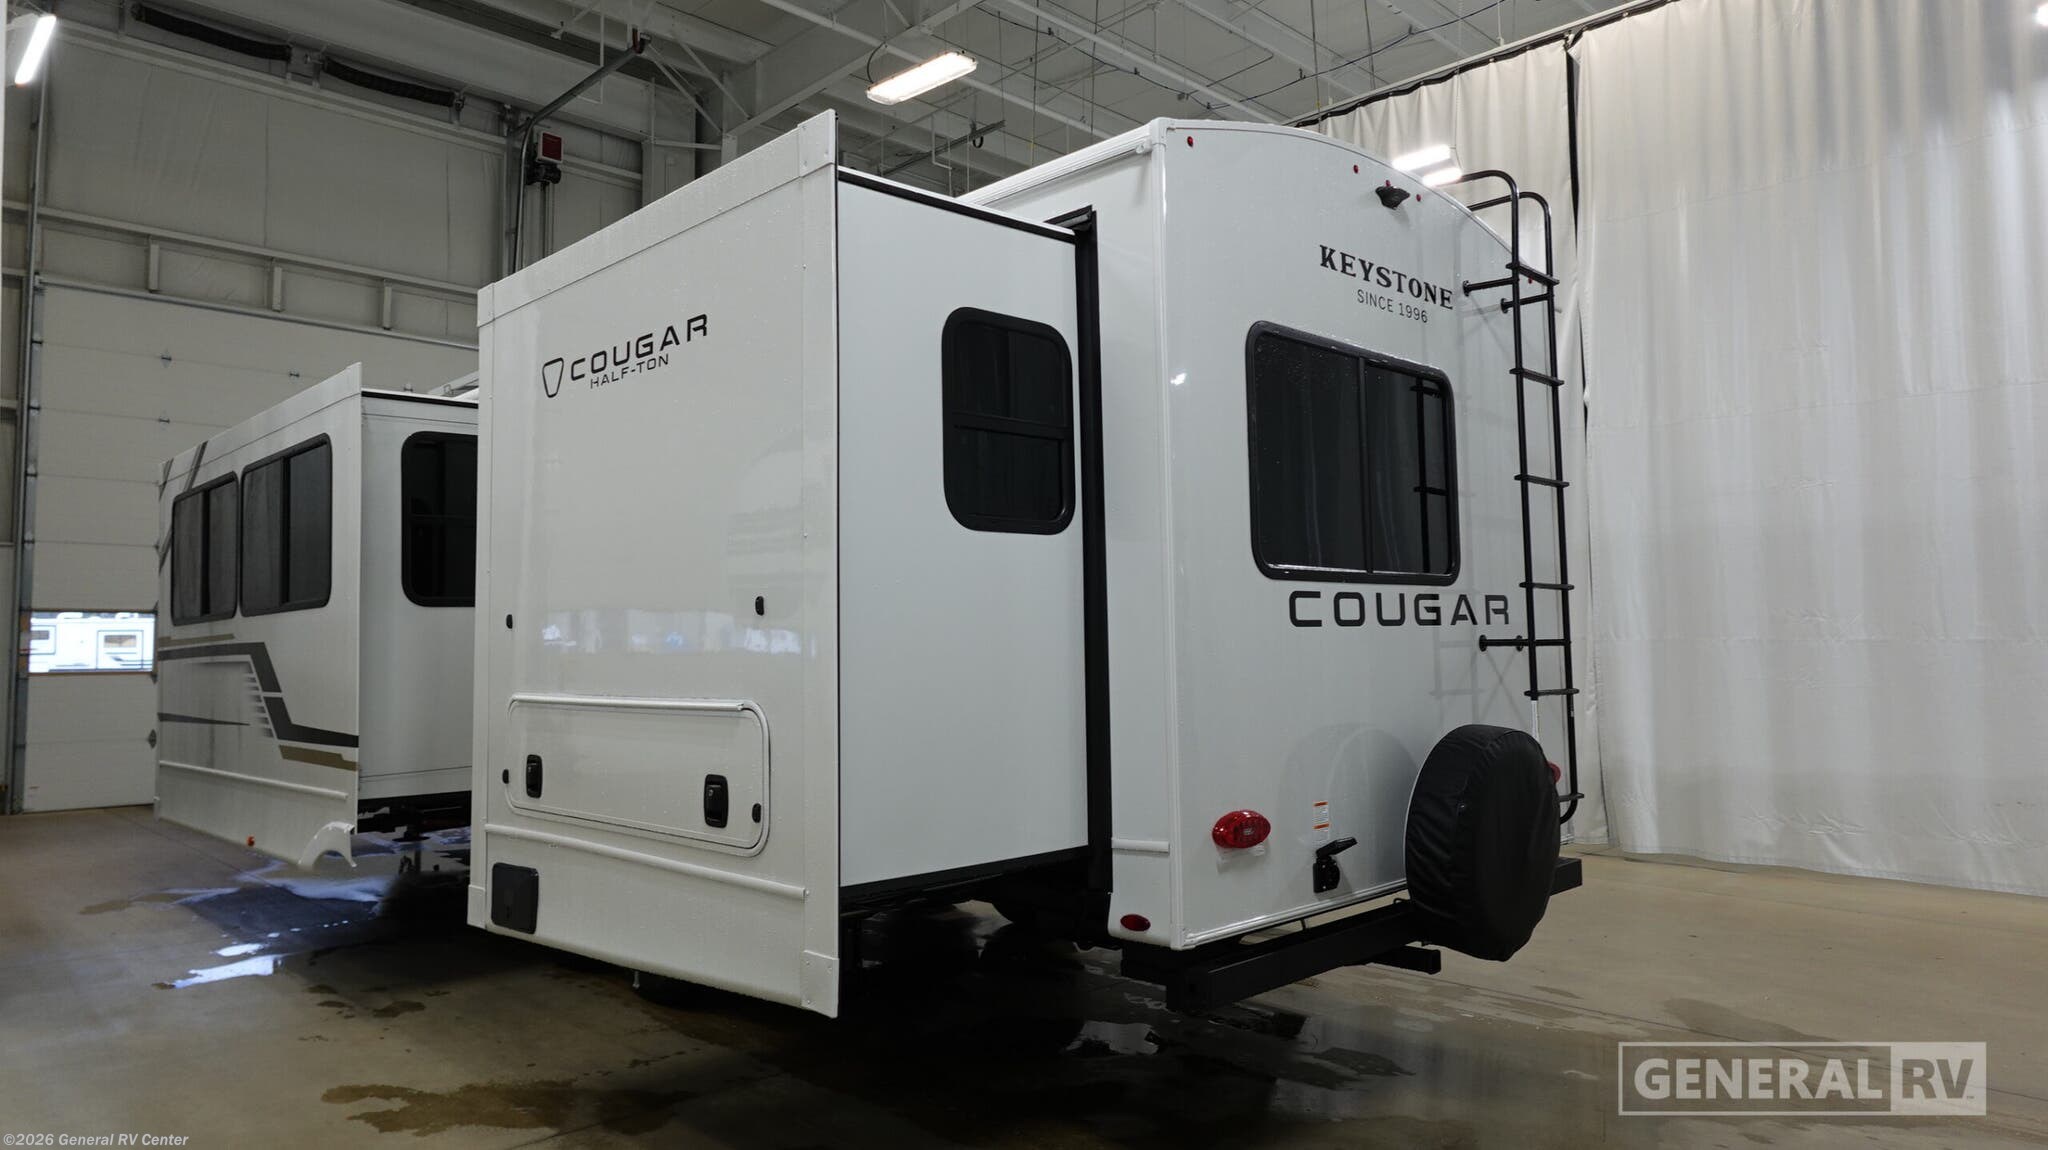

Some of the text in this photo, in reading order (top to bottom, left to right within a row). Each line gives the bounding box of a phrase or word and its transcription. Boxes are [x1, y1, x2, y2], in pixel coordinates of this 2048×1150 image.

[1319, 244, 1453, 310] KEYSTONE
[1357, 289, 1428, 323] SINCE 1996
[570, 313, 707, 381] COUGAR
[590, 353, 669, 389] HALF-TON
[1289, 590, 1509, 627] COUGAR
